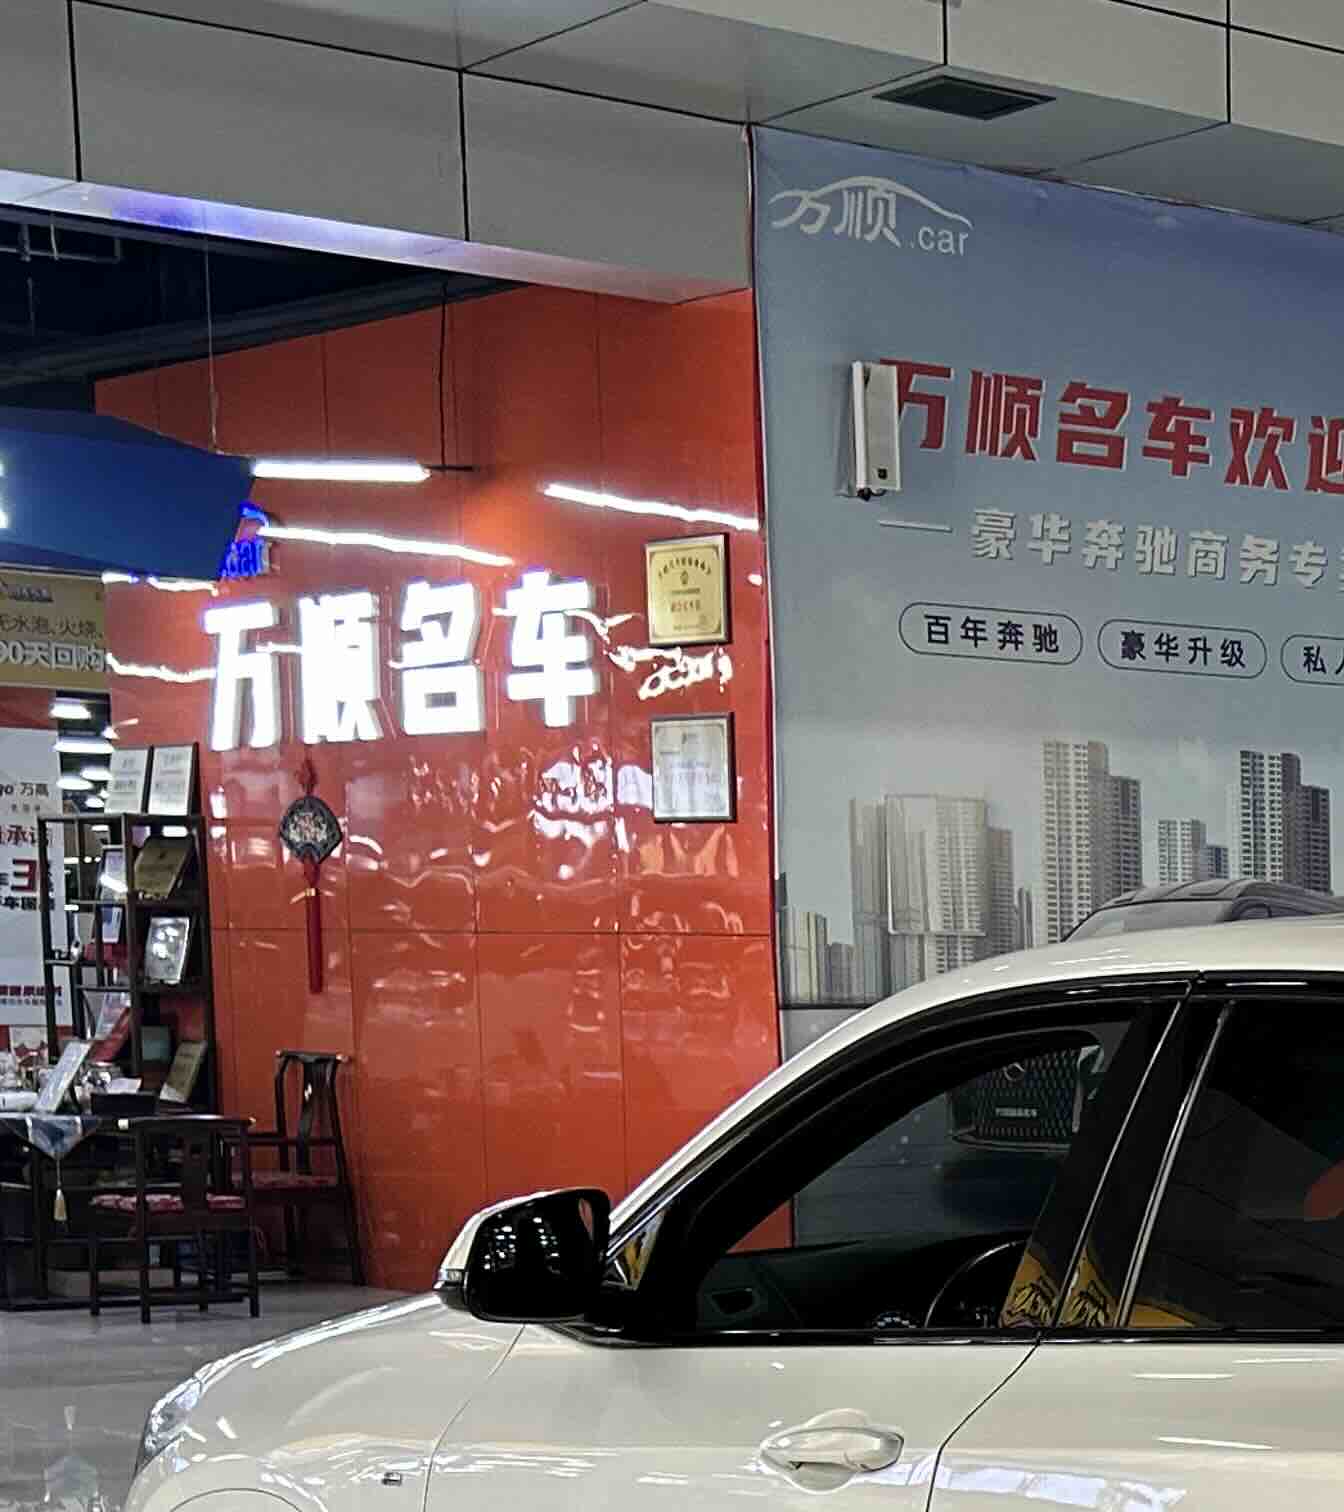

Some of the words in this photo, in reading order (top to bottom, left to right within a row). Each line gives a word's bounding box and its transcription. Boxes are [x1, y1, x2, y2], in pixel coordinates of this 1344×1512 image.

[769, 185, 901, 249] 万顺
[203, 570, 598, 752] 万顺名车
[924, 614, 1060, 657] 百年奔驰
[1119, 629, 1247, 671] 豪华升级
